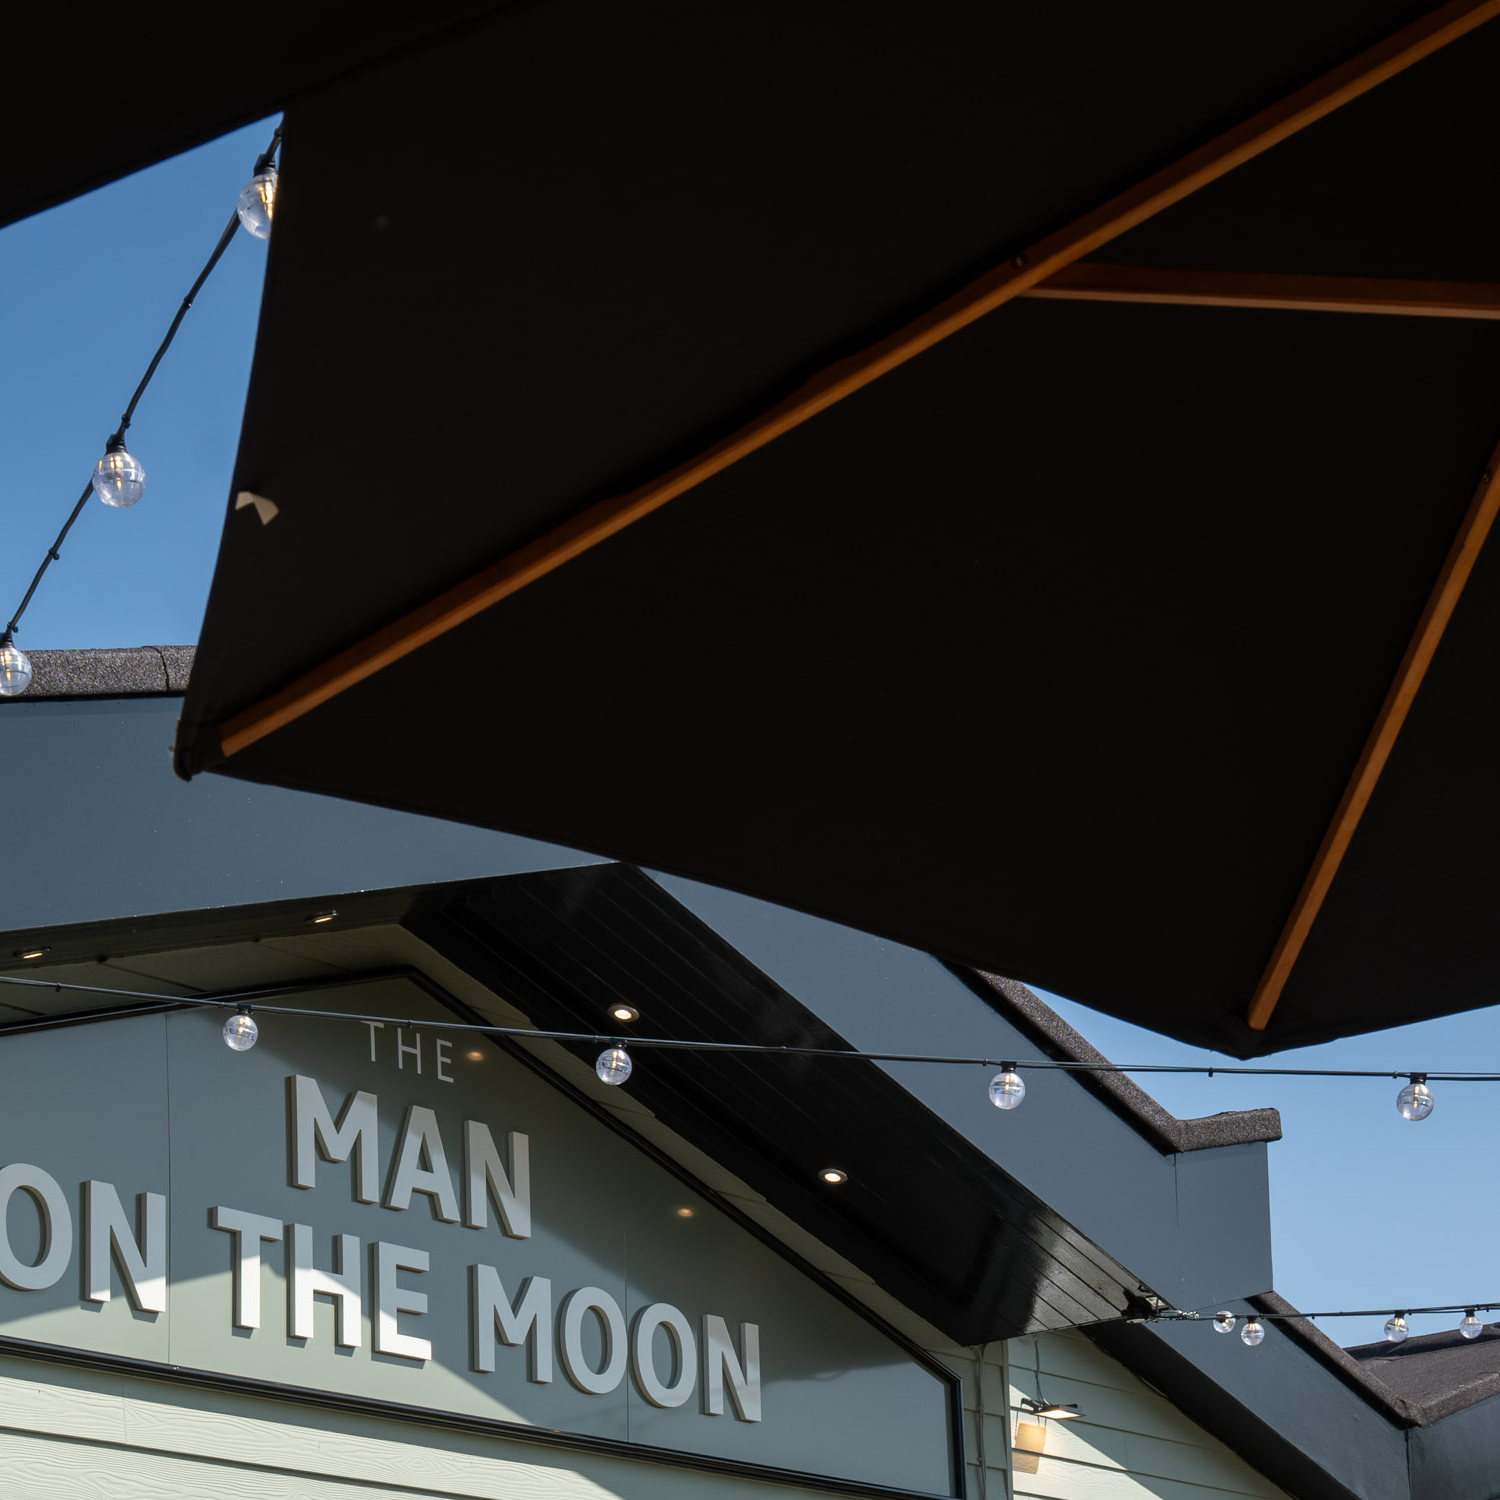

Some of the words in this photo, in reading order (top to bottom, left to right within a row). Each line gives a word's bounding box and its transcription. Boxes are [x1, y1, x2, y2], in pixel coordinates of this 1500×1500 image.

[359, 1020, 456, 1084] THE
[285, 1073, 532, 1240] MAN
[212, 1205, 432, 1361] THE
[468, 1263, 762, 1423] MOON
